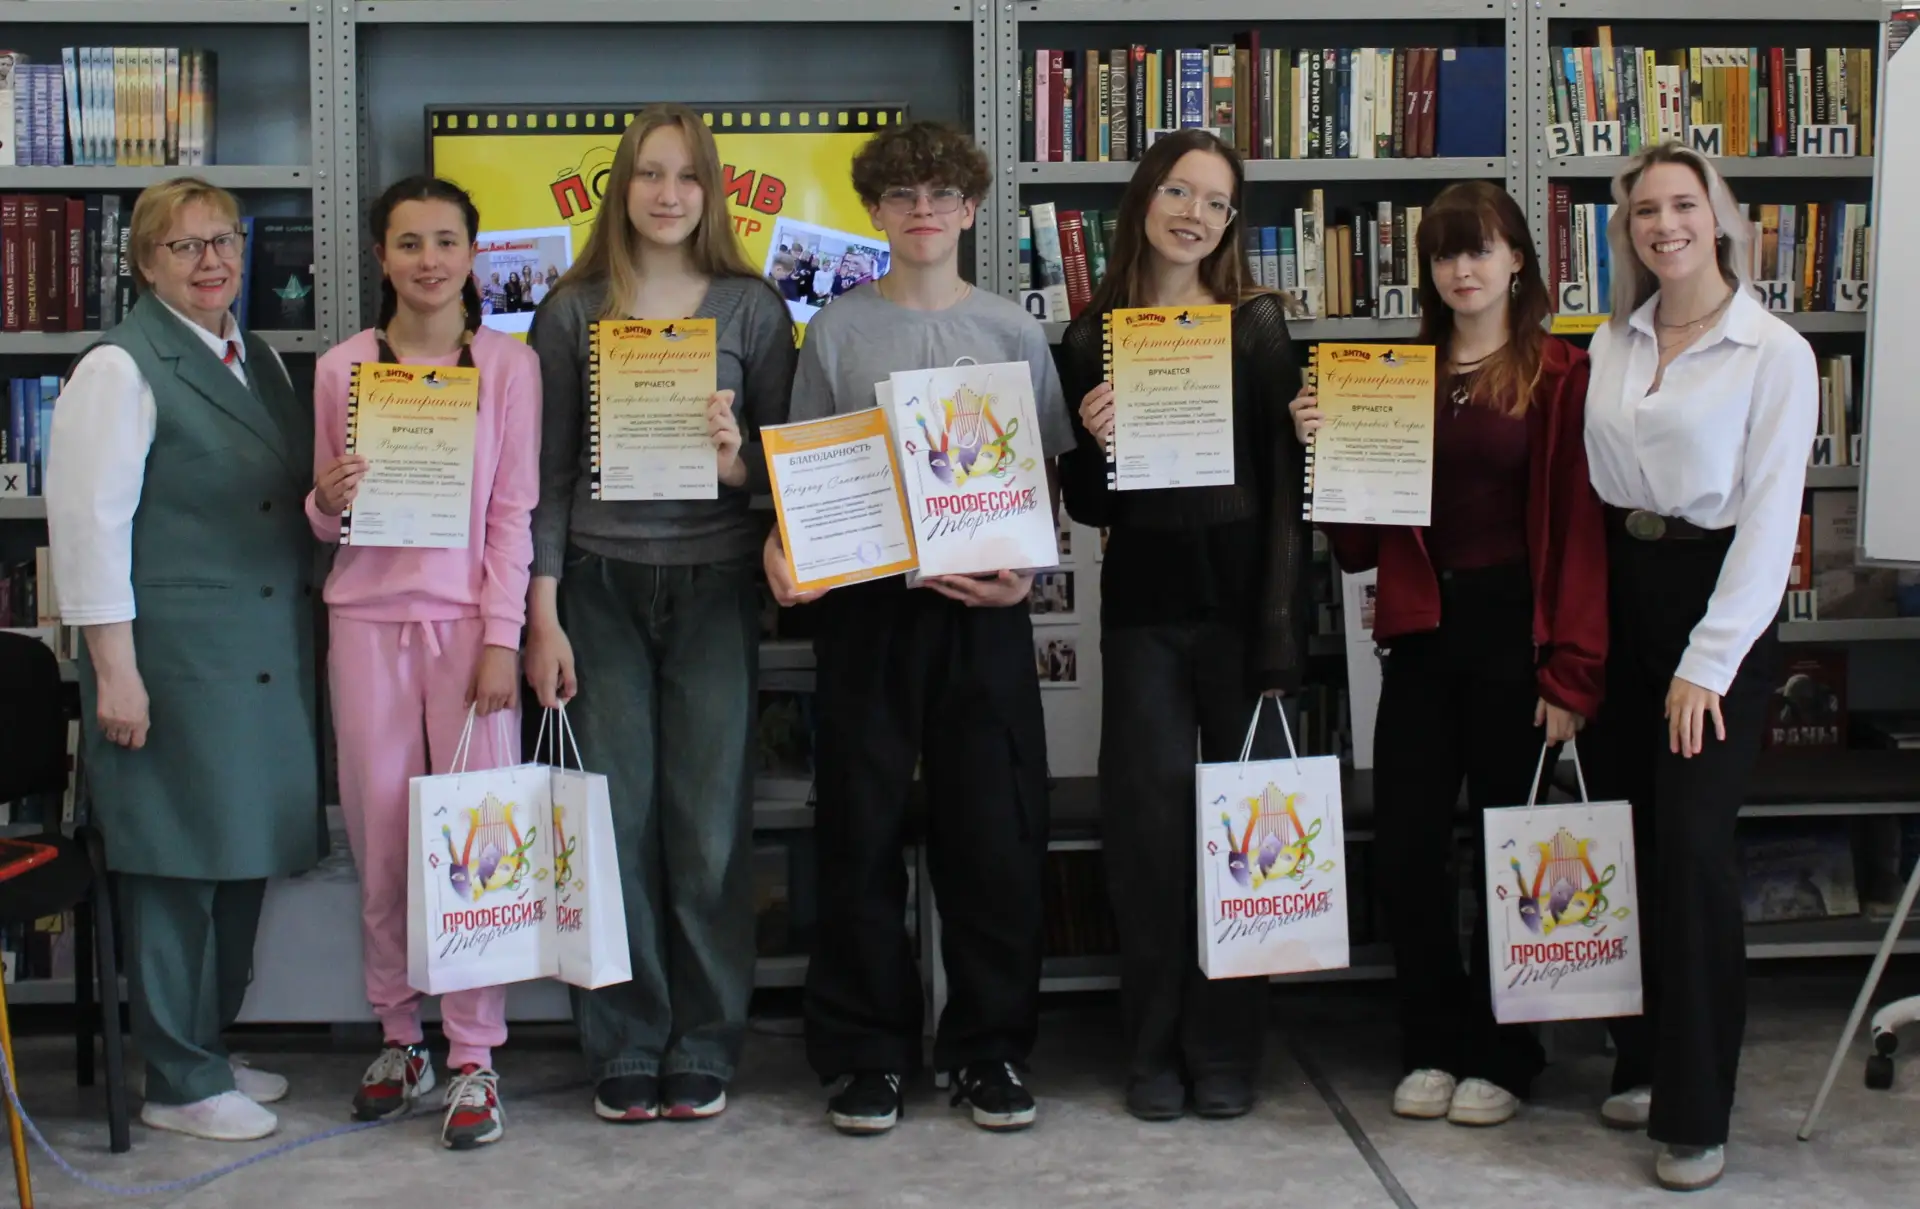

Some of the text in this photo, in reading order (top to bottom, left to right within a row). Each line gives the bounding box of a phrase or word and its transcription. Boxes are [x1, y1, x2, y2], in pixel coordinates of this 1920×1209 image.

[1311, 53, 1320, 119] ГОНЧАРОВ
[1815, 65, 1824, 120] ПОЩЕЧИНА
[1111, 66, 1127, 151] ДЕКАМЕРОН
[1325, 115, 1333, 148] ГОНЧАРОВ
[1555, 128, 1570, 154] З
[1592, 125, 1612, 151] К
[1694, 127, 1719, 152] М
[1804, 128, 1848, 154] Н П
[6, 277, 15, 324] ПИСАТЕЛИ
[28, 272, 37, 322] ПИСАТЕЛИ
[1562, 284, 1584, 311] С
[608, 346, 711, 366] Сертификат
[1120, 332, 1226, 354] Сертификат
[634, 380, 676, 388] ВРУЧАЕТСЯ
[1148, 367, 1190, 376] ВРУЧАЕТСЯ
[1325, 368, 1429, 390] Сертификат
[367, 388, 472, 411] Сертификат
[1352, 405, 1393, 413] ВРУЧАЕТСЯ
[392, 425, 434, 435] ВРУЧАЕТСЯ
[789, 443, 872, 466] БЛАГОДАРНОСТЬ
[1813, 438, 1831, 466] И
[4, 475, 18, 491] Х
[926, 489, 1033, 517] ПРОФЕССИЯ
[442, 899, 542, 933] ПРОФЕССИЯ
[1221, 891, 1329, 920] ПРОФЕССИЯ
[1511, 938, 1625, 965] ПРОФЕССИЯ
